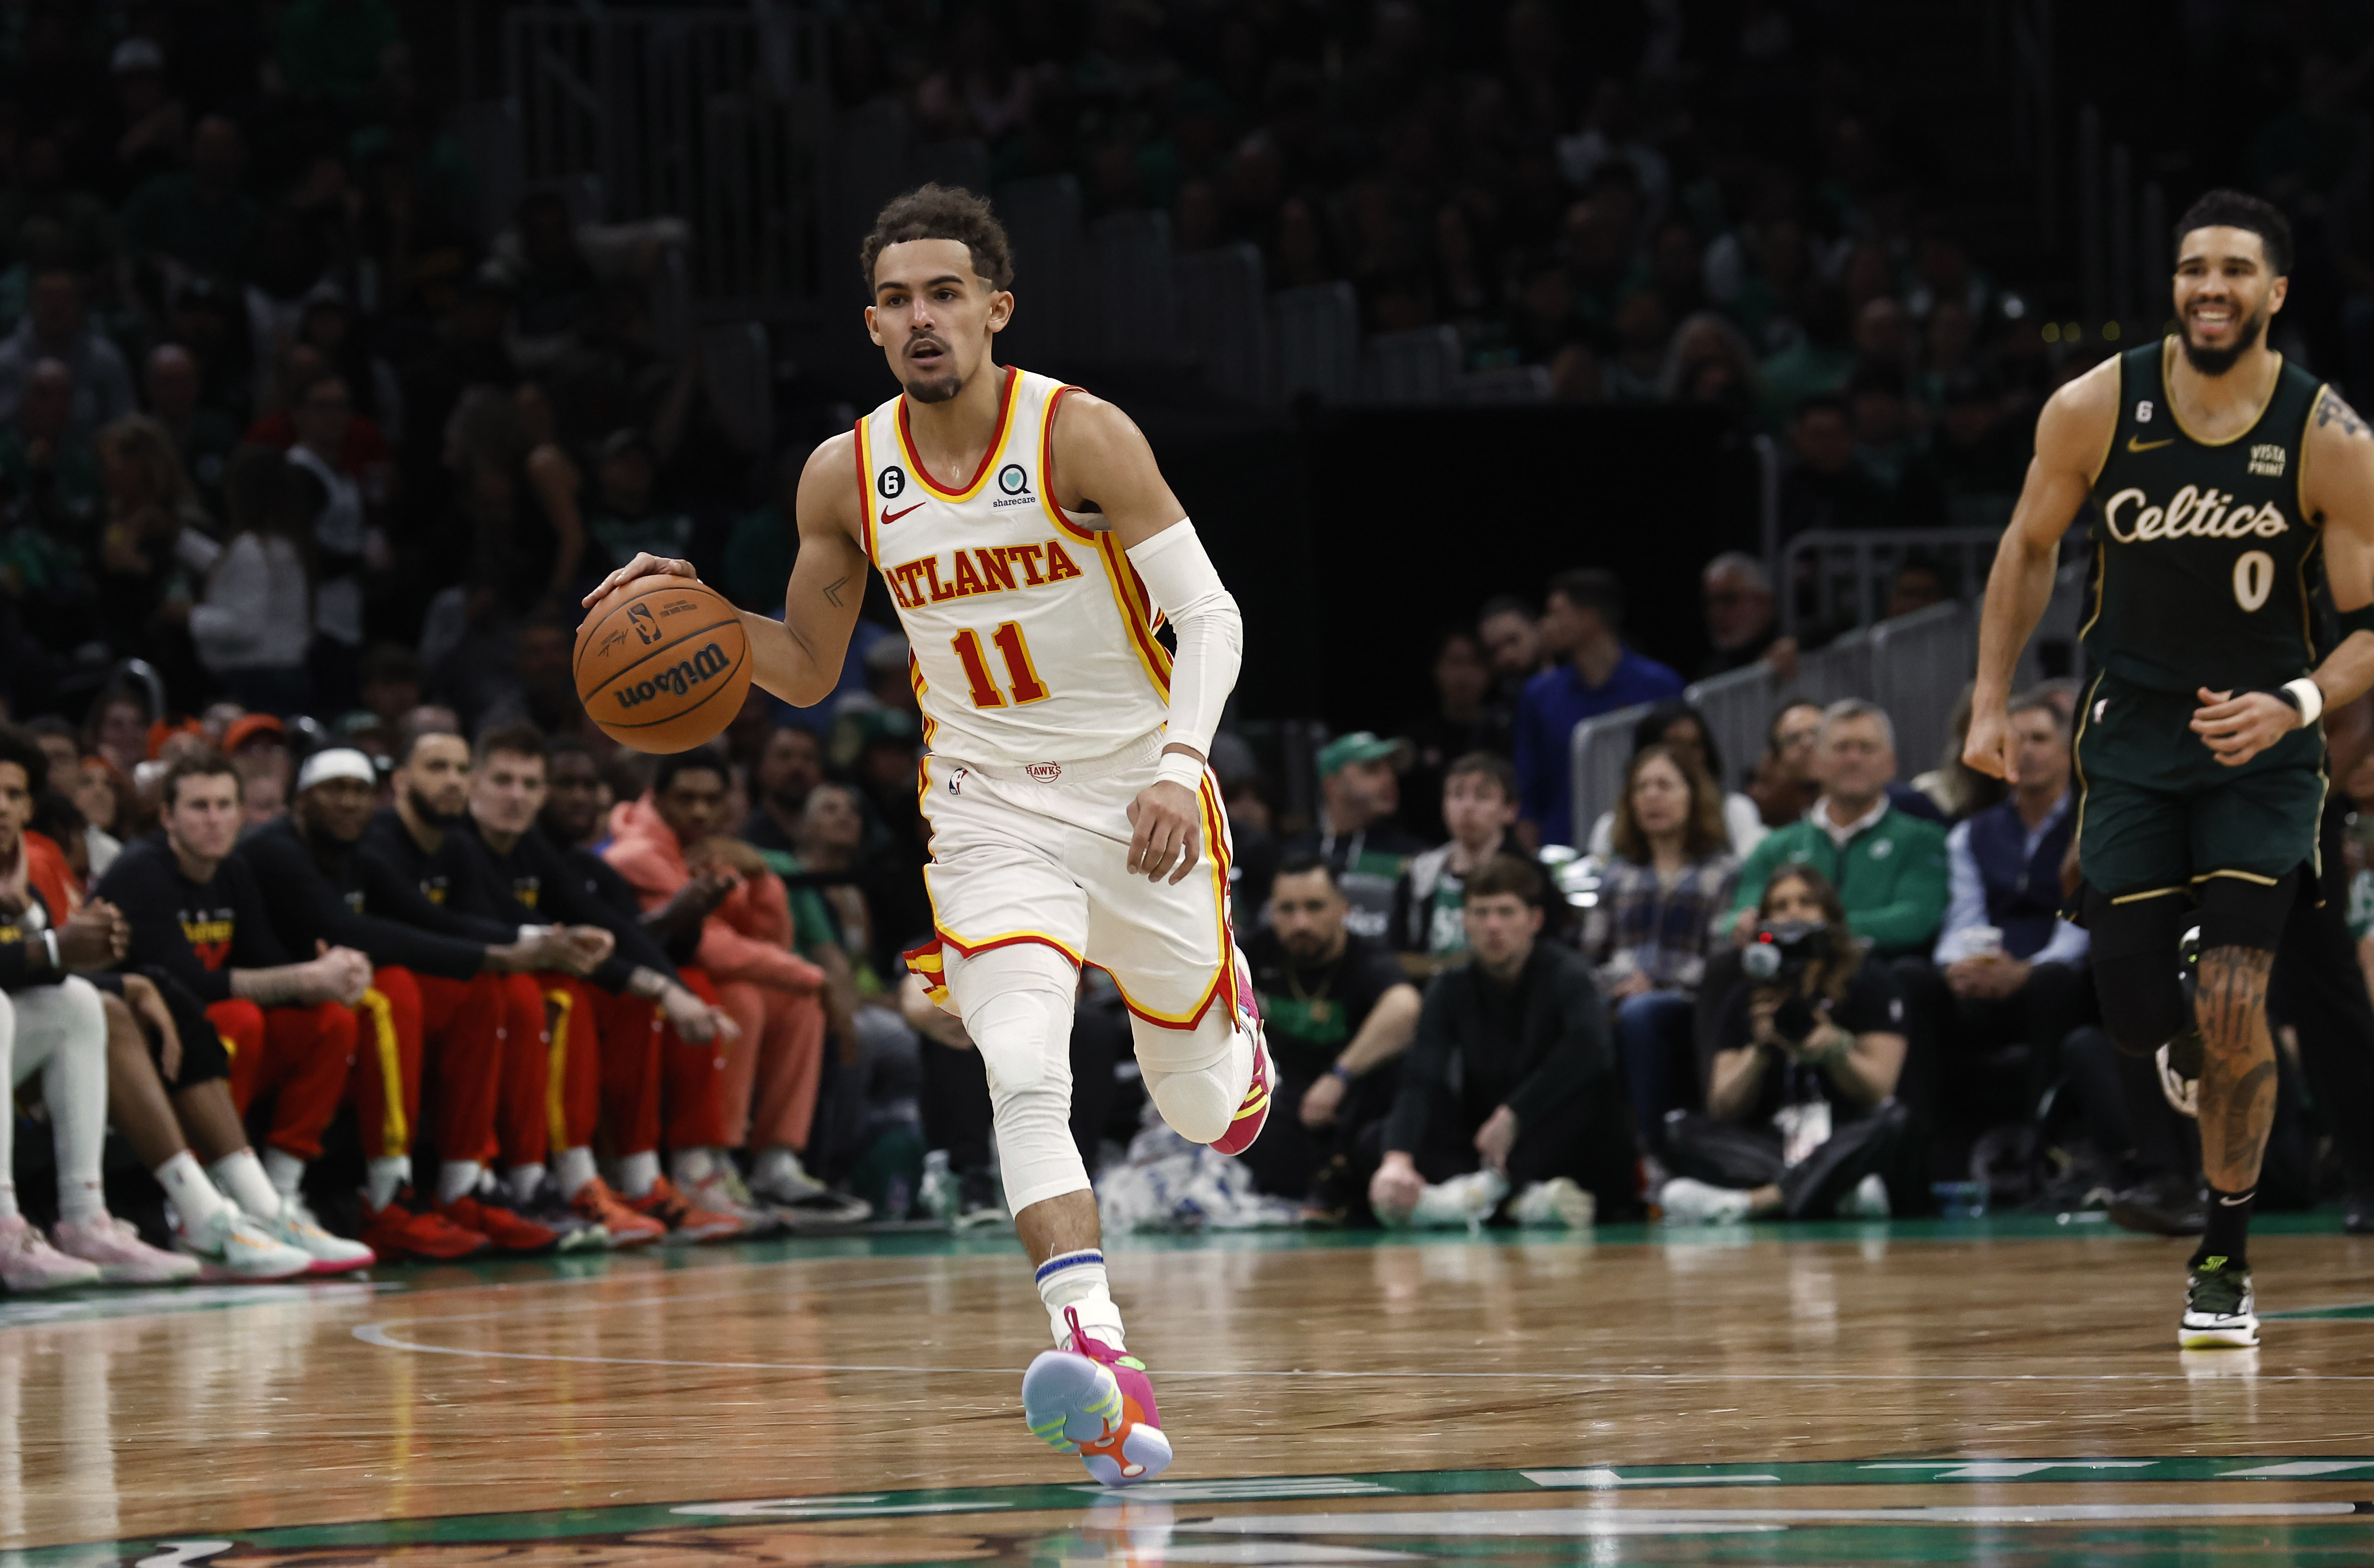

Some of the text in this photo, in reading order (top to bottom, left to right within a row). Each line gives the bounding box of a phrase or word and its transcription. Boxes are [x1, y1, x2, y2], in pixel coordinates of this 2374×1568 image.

[2136, 400, 2153, 422] 6
[2251, 445, 2286, 461] VISTA
[884, 472, 899, 495] 6
[993, 496, 1036, 507] sharecare
[2105, 483, 2289, 544] Celtics
[883, 539, 1083, 609] ATLANTA
[2233, 550, 2276, 613] 0
[615, 642, 731, 709] Wilson
[951, 620, 1051, 709] 11
[1025, 766, 1061, 775] HAWKS
